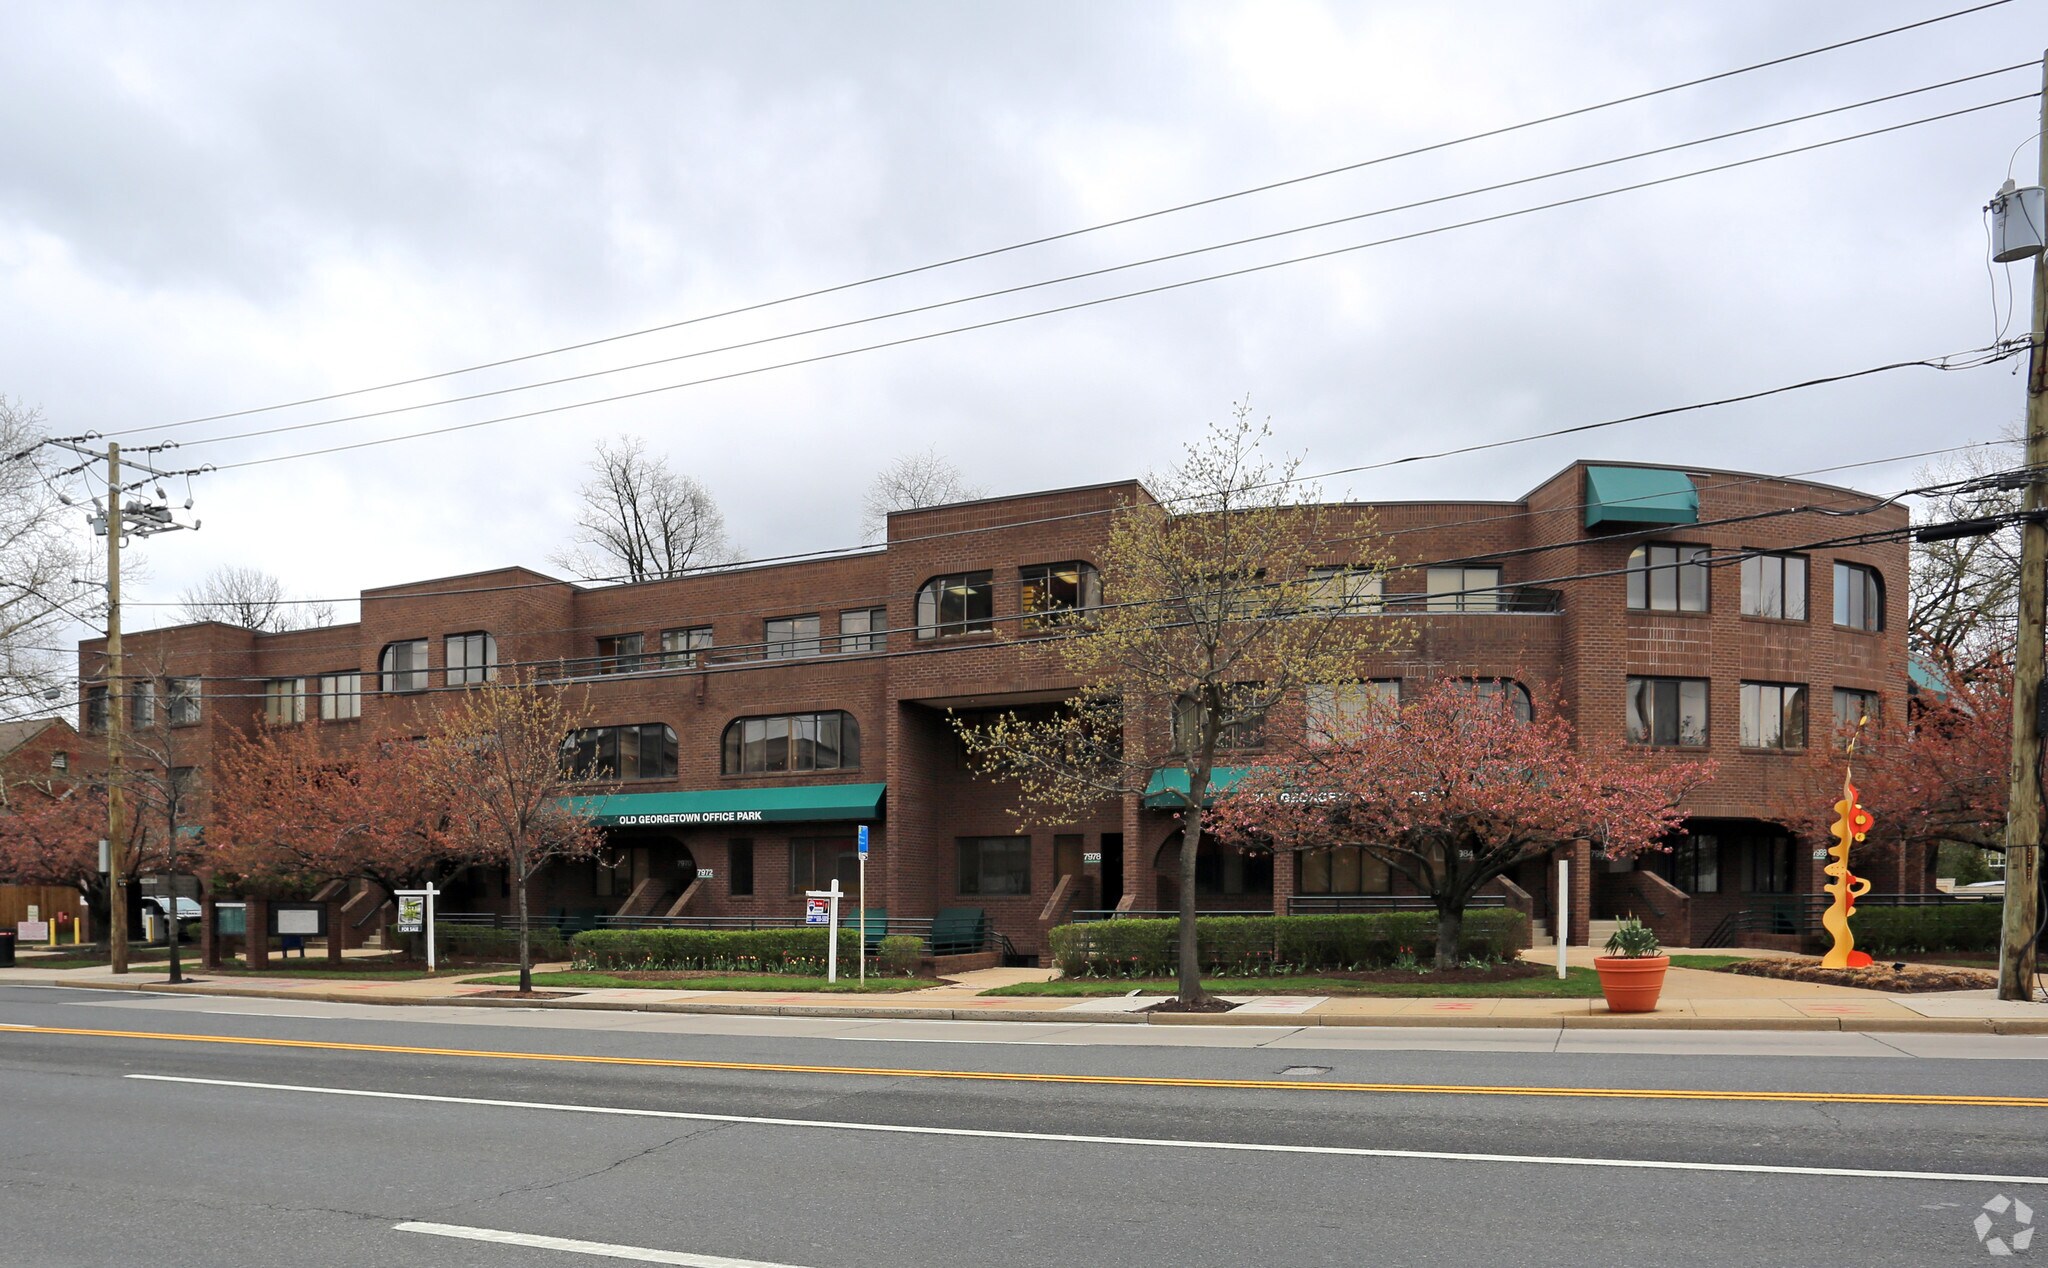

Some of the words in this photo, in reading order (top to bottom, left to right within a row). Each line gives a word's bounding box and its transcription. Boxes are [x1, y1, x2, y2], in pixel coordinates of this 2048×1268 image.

[619, 815, 637, 825] OLD
[638, 813, 700, 824] GEORGETOWN
[702, 811, 735, 822] OFFICE
[737, 811, 762, 821] PARK
[1083, 852, 1101, 861] 7978
[696, 868, 714, 876] 7972
